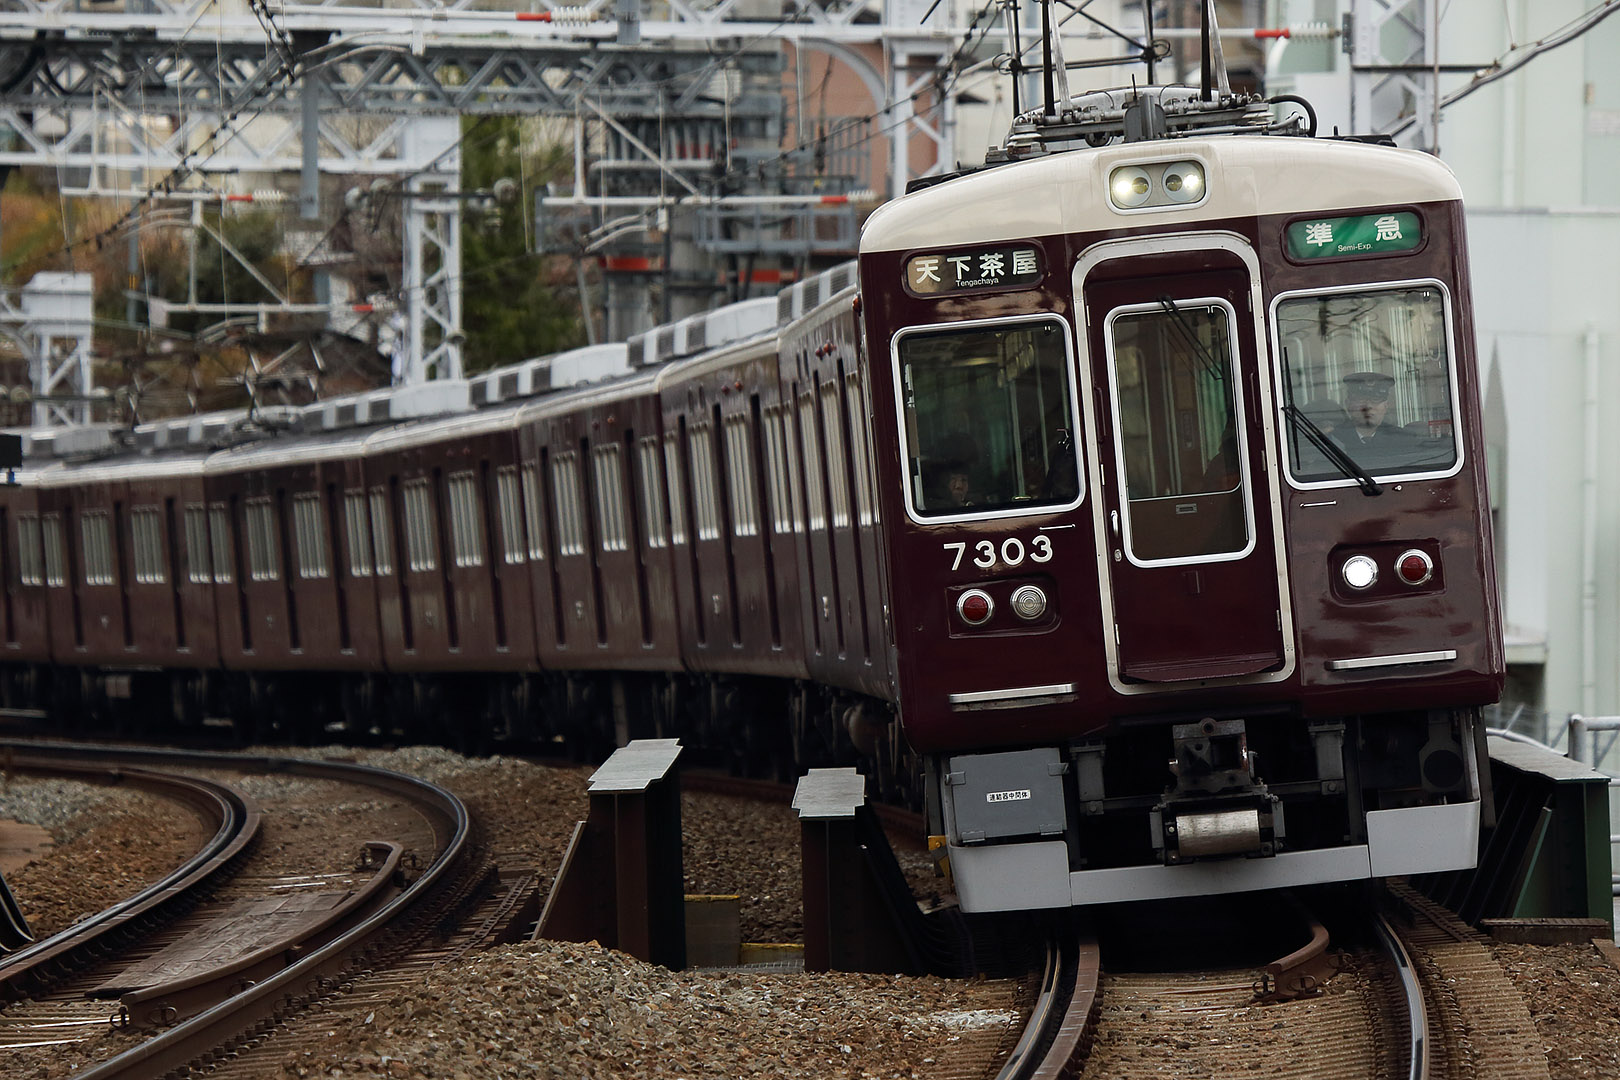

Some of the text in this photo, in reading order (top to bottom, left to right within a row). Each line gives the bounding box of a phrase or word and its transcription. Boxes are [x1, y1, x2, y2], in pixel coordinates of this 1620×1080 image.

[1305, 216, 1402, 247] 準急
[1337, 243, 1373, 252] Semi-Exp.
[914, 249, 1038, 284] 天下茶屋
[955, 277, 999, 287] Tengachaya
[943, 534, 1053, 571] 7303
